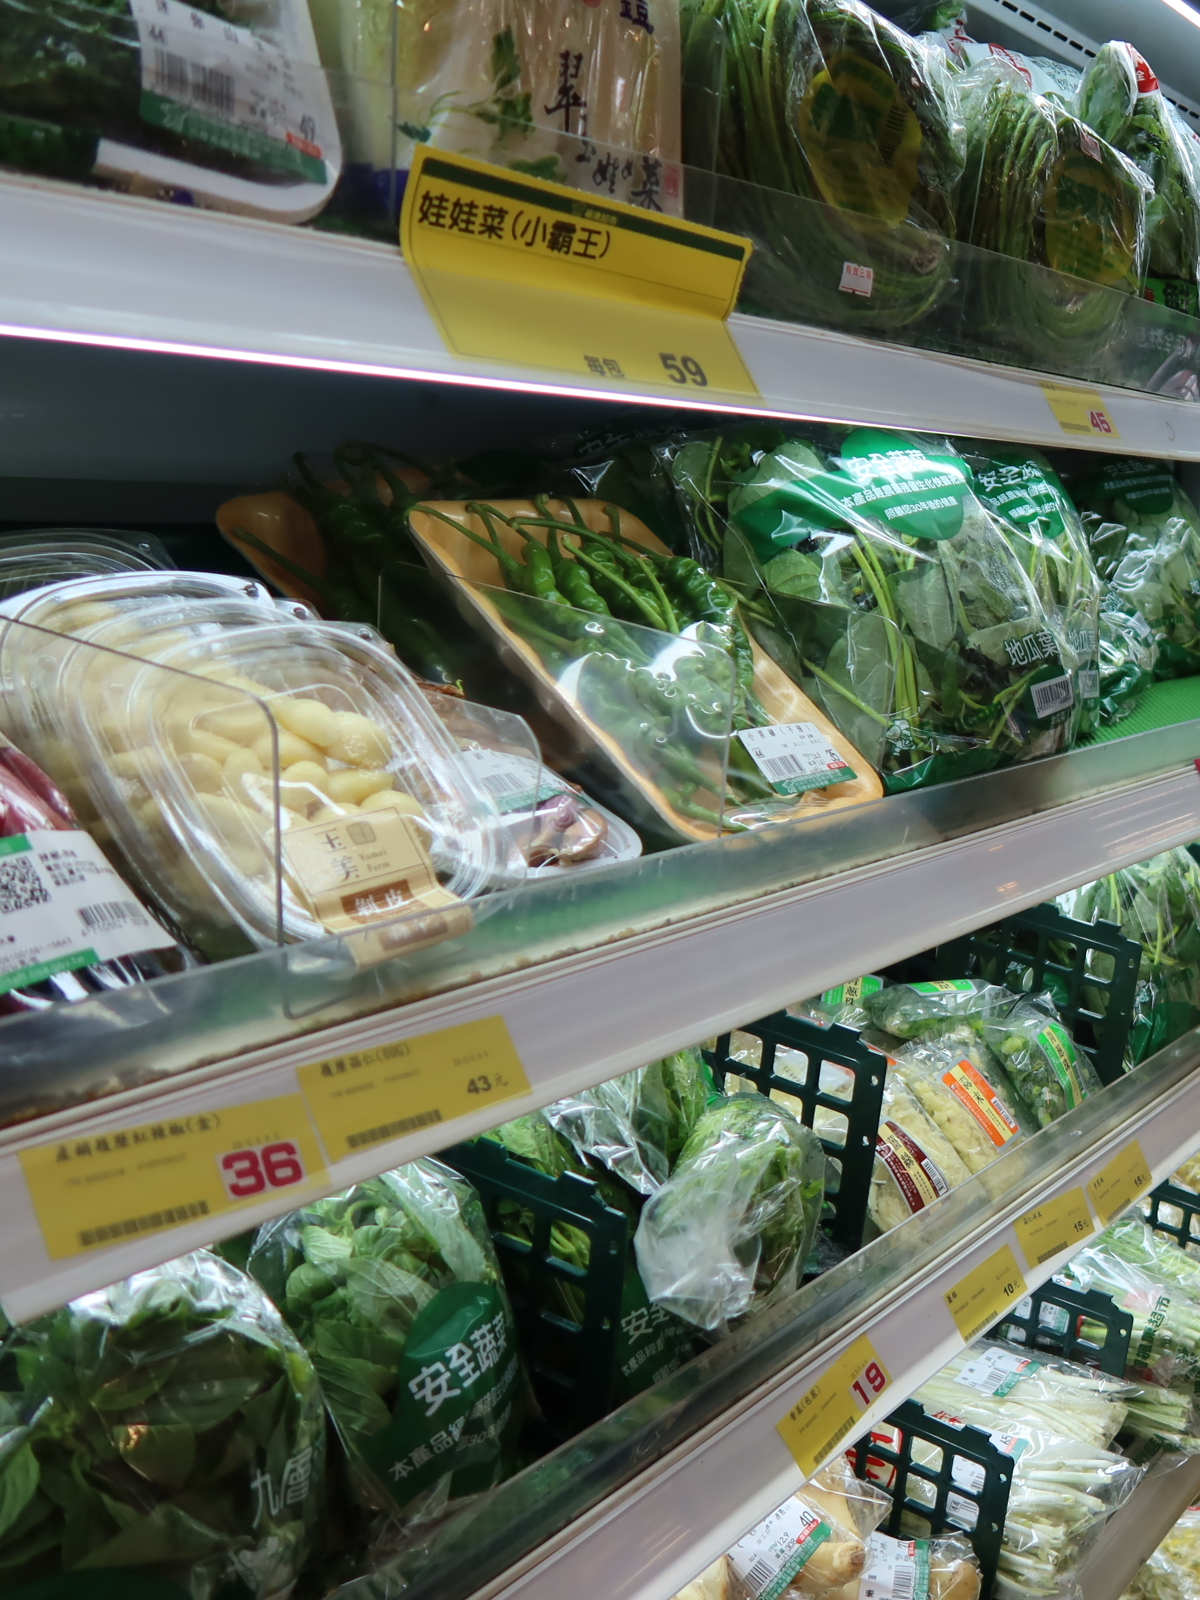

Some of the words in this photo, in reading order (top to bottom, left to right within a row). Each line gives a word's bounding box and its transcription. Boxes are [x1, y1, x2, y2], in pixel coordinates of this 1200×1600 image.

[418, 190, 611, 259] 娃娃菜(小霸王)
[584, 354, 626, 378] 每包
[659, 352, 708, 387] 59
[1090, 411, 1112, 433] 45
[846, 449, 932, 483] 安全蔬菜
[1004, 629, 1060, 667] 地瓜葉
[366, 861, 391, 873] Farm
[221, 1141, 303, 1197] 36
[1003, 1280, 1021, 1298] 10元
[852, 1361, 886, 1406] 19
[951, 1500, 960, 1512] 44
[799, 1510, 816, 1527] 40
[777, 1531, 790, 1546] 12.9
[784, 1537, 797, 1552] 308
